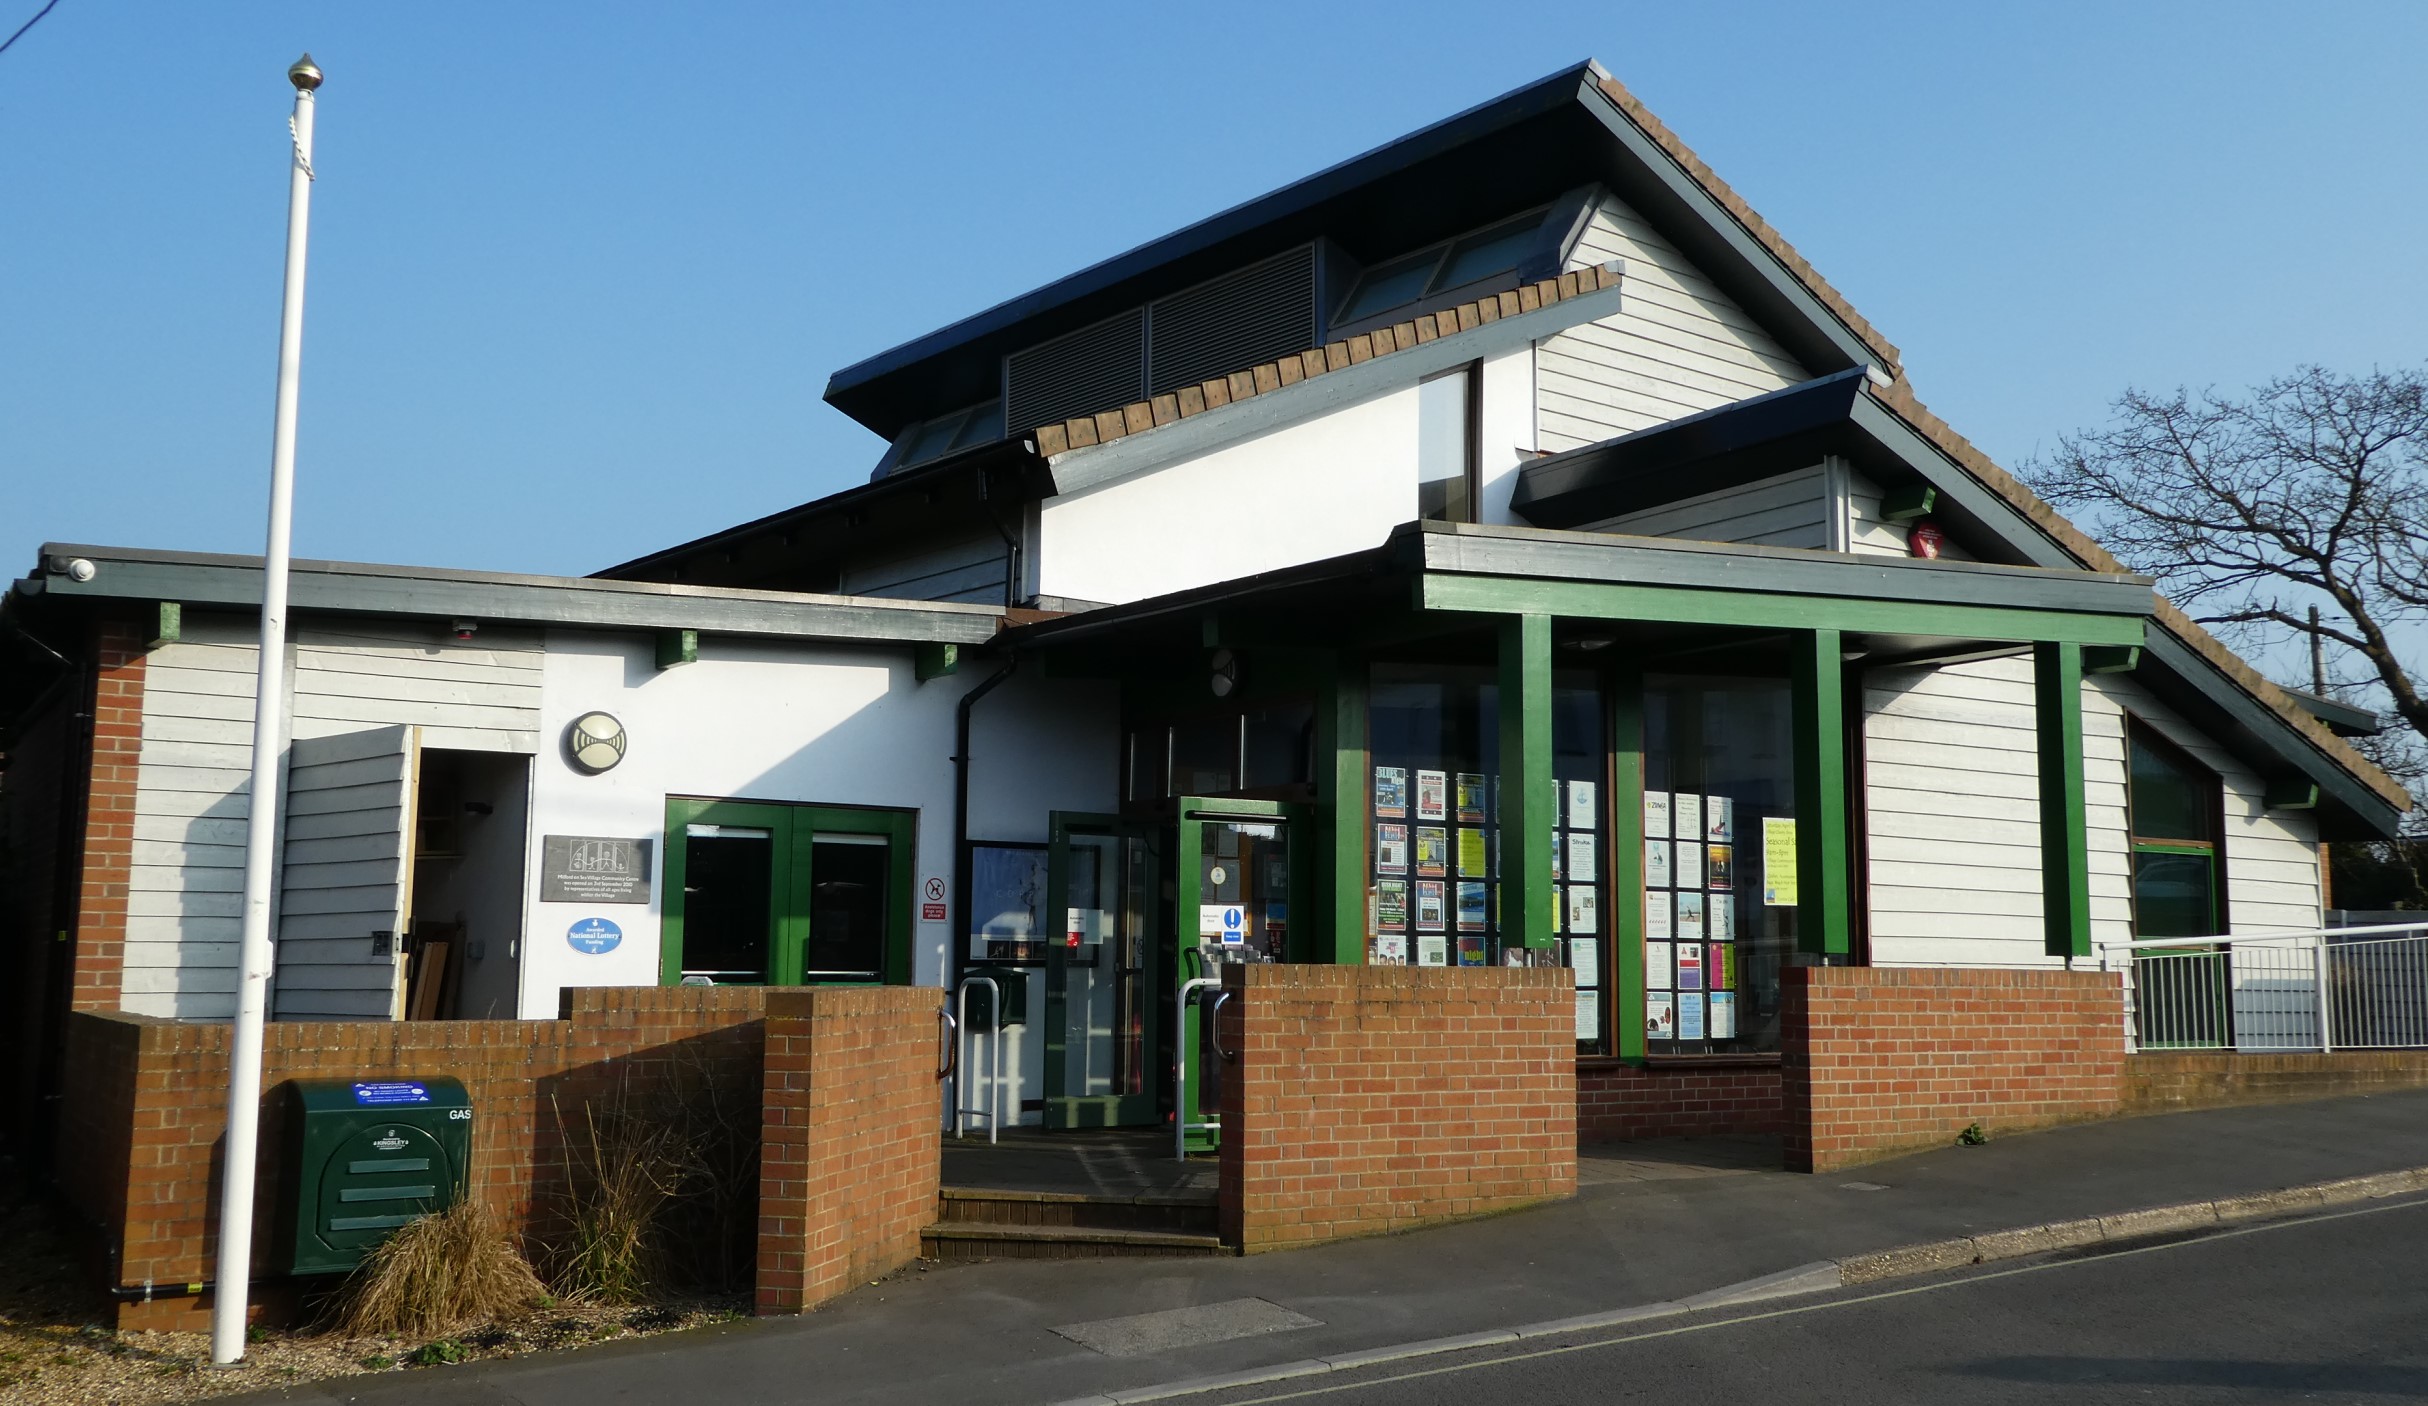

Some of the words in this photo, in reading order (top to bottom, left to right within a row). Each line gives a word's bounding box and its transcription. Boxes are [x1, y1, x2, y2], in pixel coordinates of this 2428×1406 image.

[1377, 768, 1398, 778] BLUES
[1766, 836, 1790, 845] Seasonal
[597, 932, 620, 940] Lottery
[1464, 950, 1484, 962] night
[449, 1110, 472, 1120] GAS
